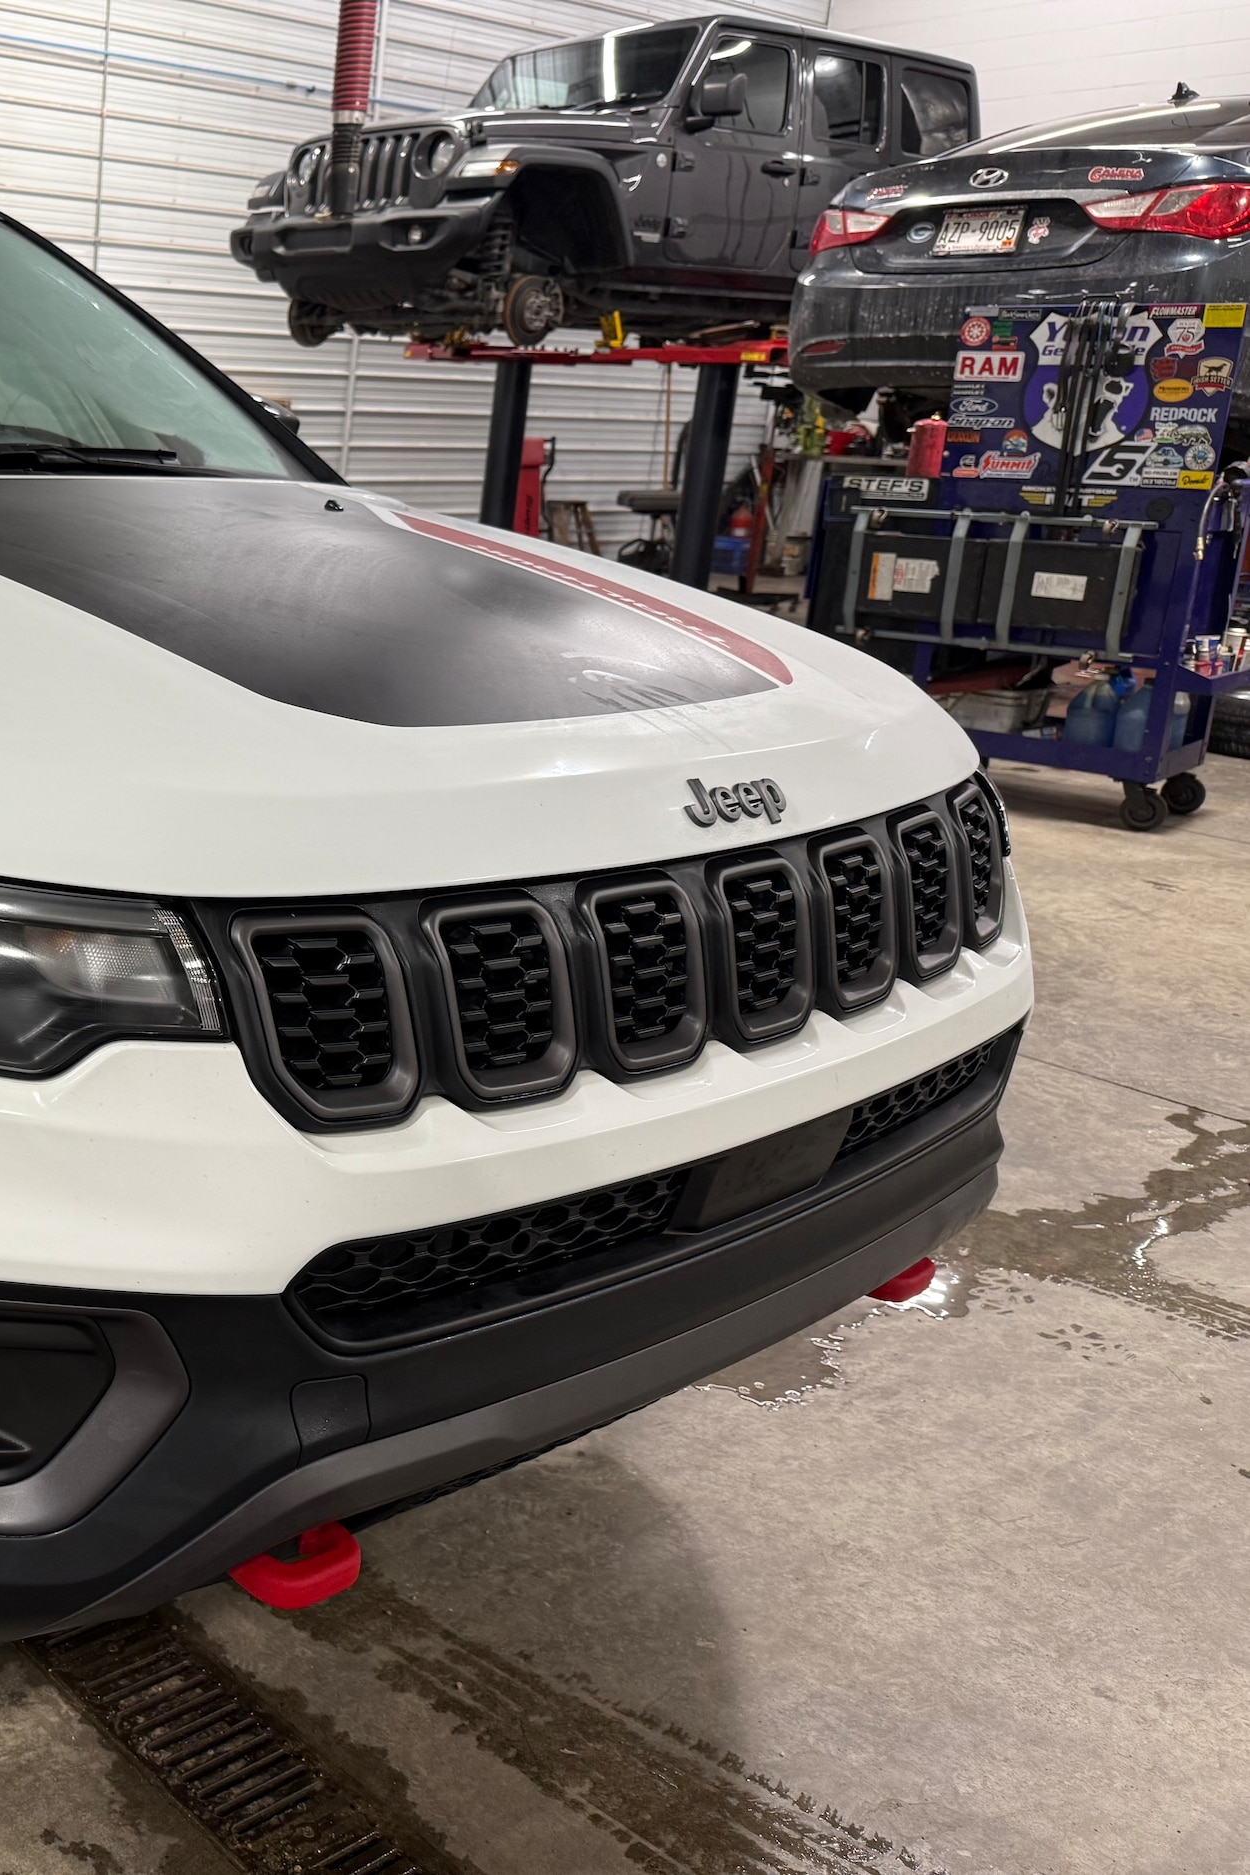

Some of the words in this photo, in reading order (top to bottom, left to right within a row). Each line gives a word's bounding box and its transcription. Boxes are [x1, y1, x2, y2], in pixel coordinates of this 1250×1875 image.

[938, 219, 1020, 244] AZP-9005
[1150, 306, 1198, 318] FLOWMASTER
[1177, 327, 1195, 343] 75
[959, 356, 1020, 377] RAM
[959, 399, 990, 413] Ford
[1150, 407, 1218, 423] REDROCK
[849, 478, 925, 493] STEF'S
[684, 778, 787, 828] Jeep
